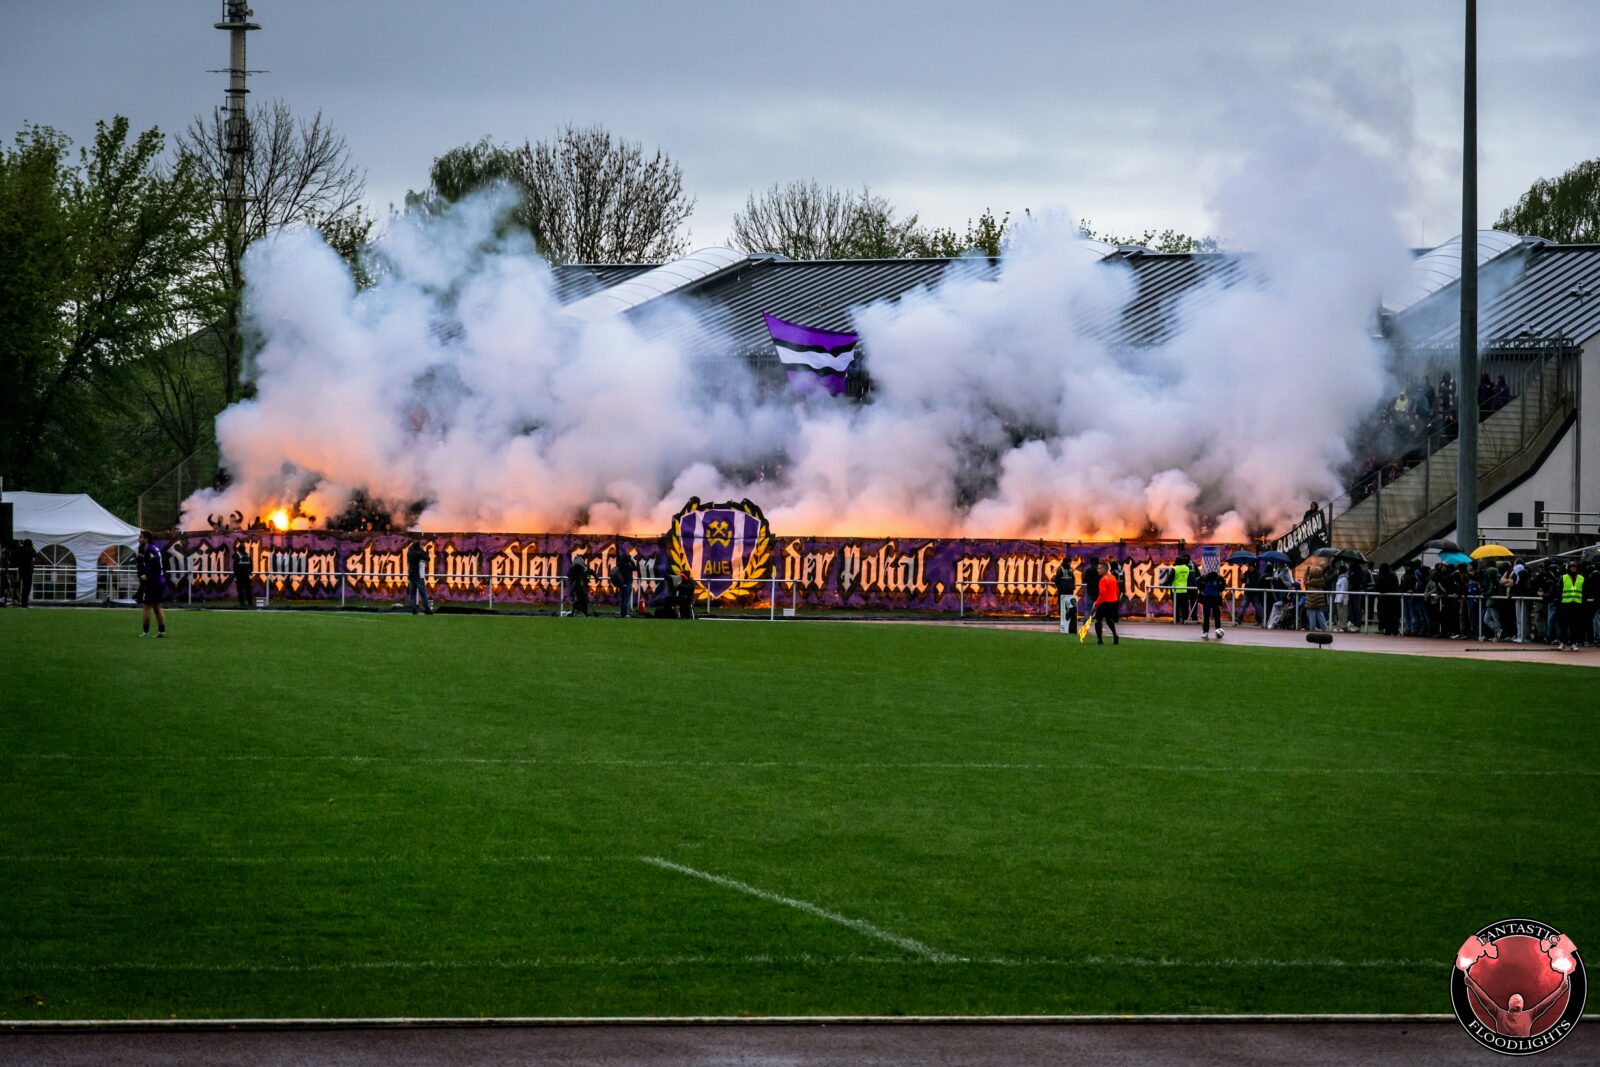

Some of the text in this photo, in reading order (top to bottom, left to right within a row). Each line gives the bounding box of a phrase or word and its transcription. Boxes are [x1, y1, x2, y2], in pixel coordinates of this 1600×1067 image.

[446, 544, 483, 590] im
[491, 541, 561, 590] edlen
[703, 560, 731, 575] AUE
[784, 538, 835, 590] der
[956, 556, 990, 595] er
